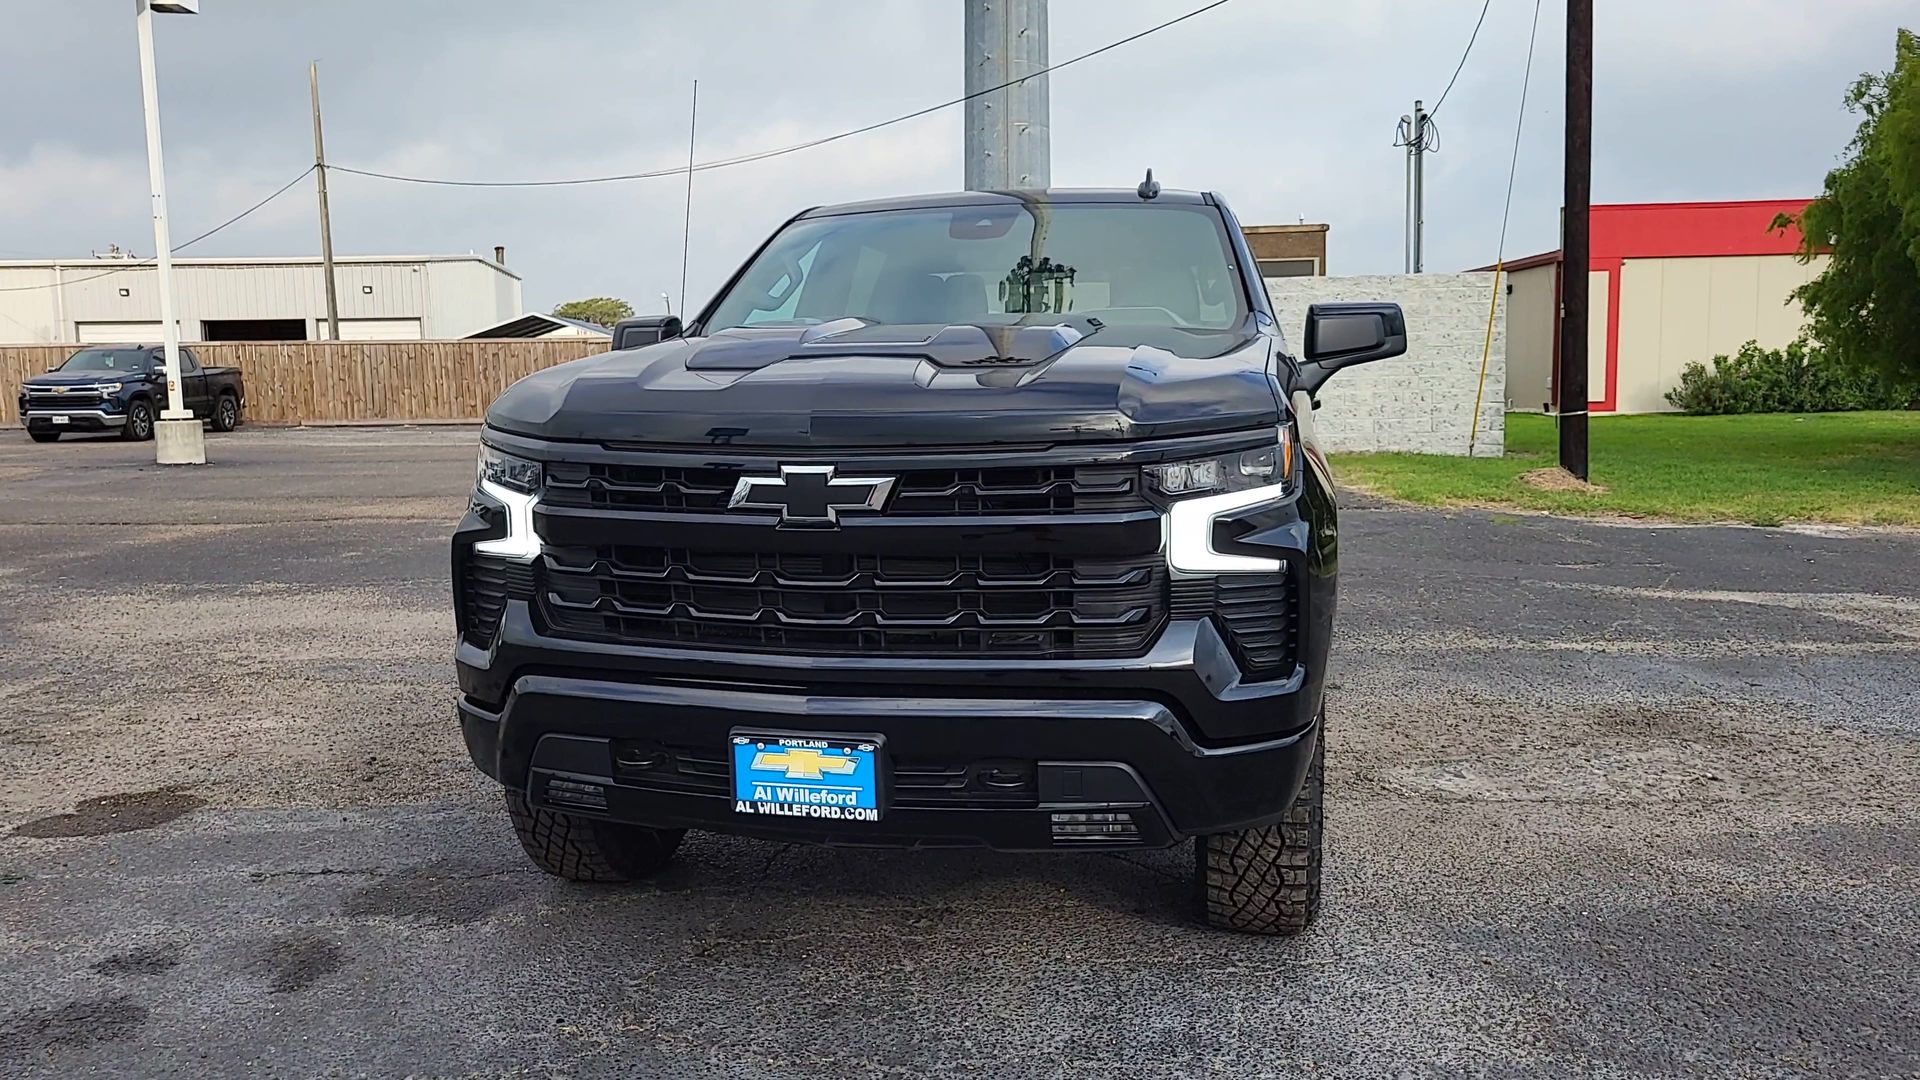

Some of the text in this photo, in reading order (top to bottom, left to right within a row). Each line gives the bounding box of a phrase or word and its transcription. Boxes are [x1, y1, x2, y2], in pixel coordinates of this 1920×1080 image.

[779, 739, 828, 748] PORTLAND
[754, 786, 857, 806] Al Willeford
[735, 801, 878, 821] AL WILLEFORD.COM
